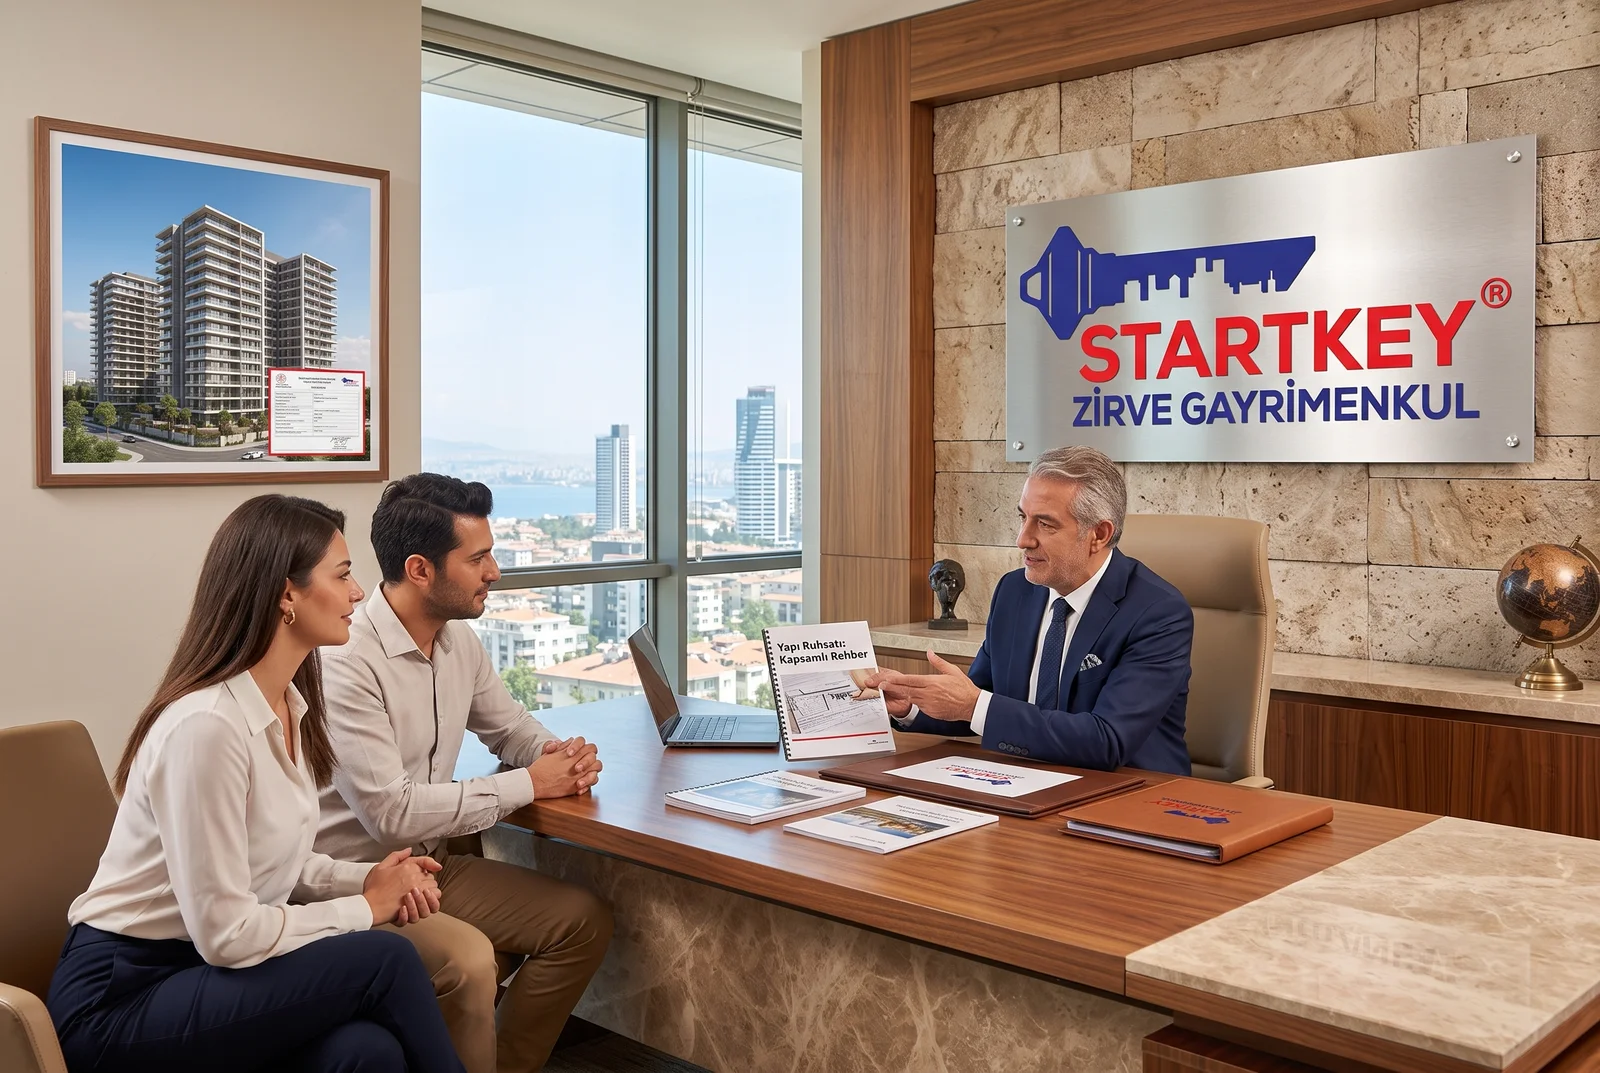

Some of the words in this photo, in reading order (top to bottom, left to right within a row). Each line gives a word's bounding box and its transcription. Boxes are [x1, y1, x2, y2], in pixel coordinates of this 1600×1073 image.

[1079, 299, 1475, 383] STARTKEY
[1073, 387, 1172, 427] ZİRVE
[1181, 380, 1478, 424] GAYRİMENKUL
[777, 642, 800, 653] Yapı
[802, 640, 846, 651] Ruhsatı:
[780, 652, 828, 665] Kapsamlı
[831, 650, 868, 661] Rehber
